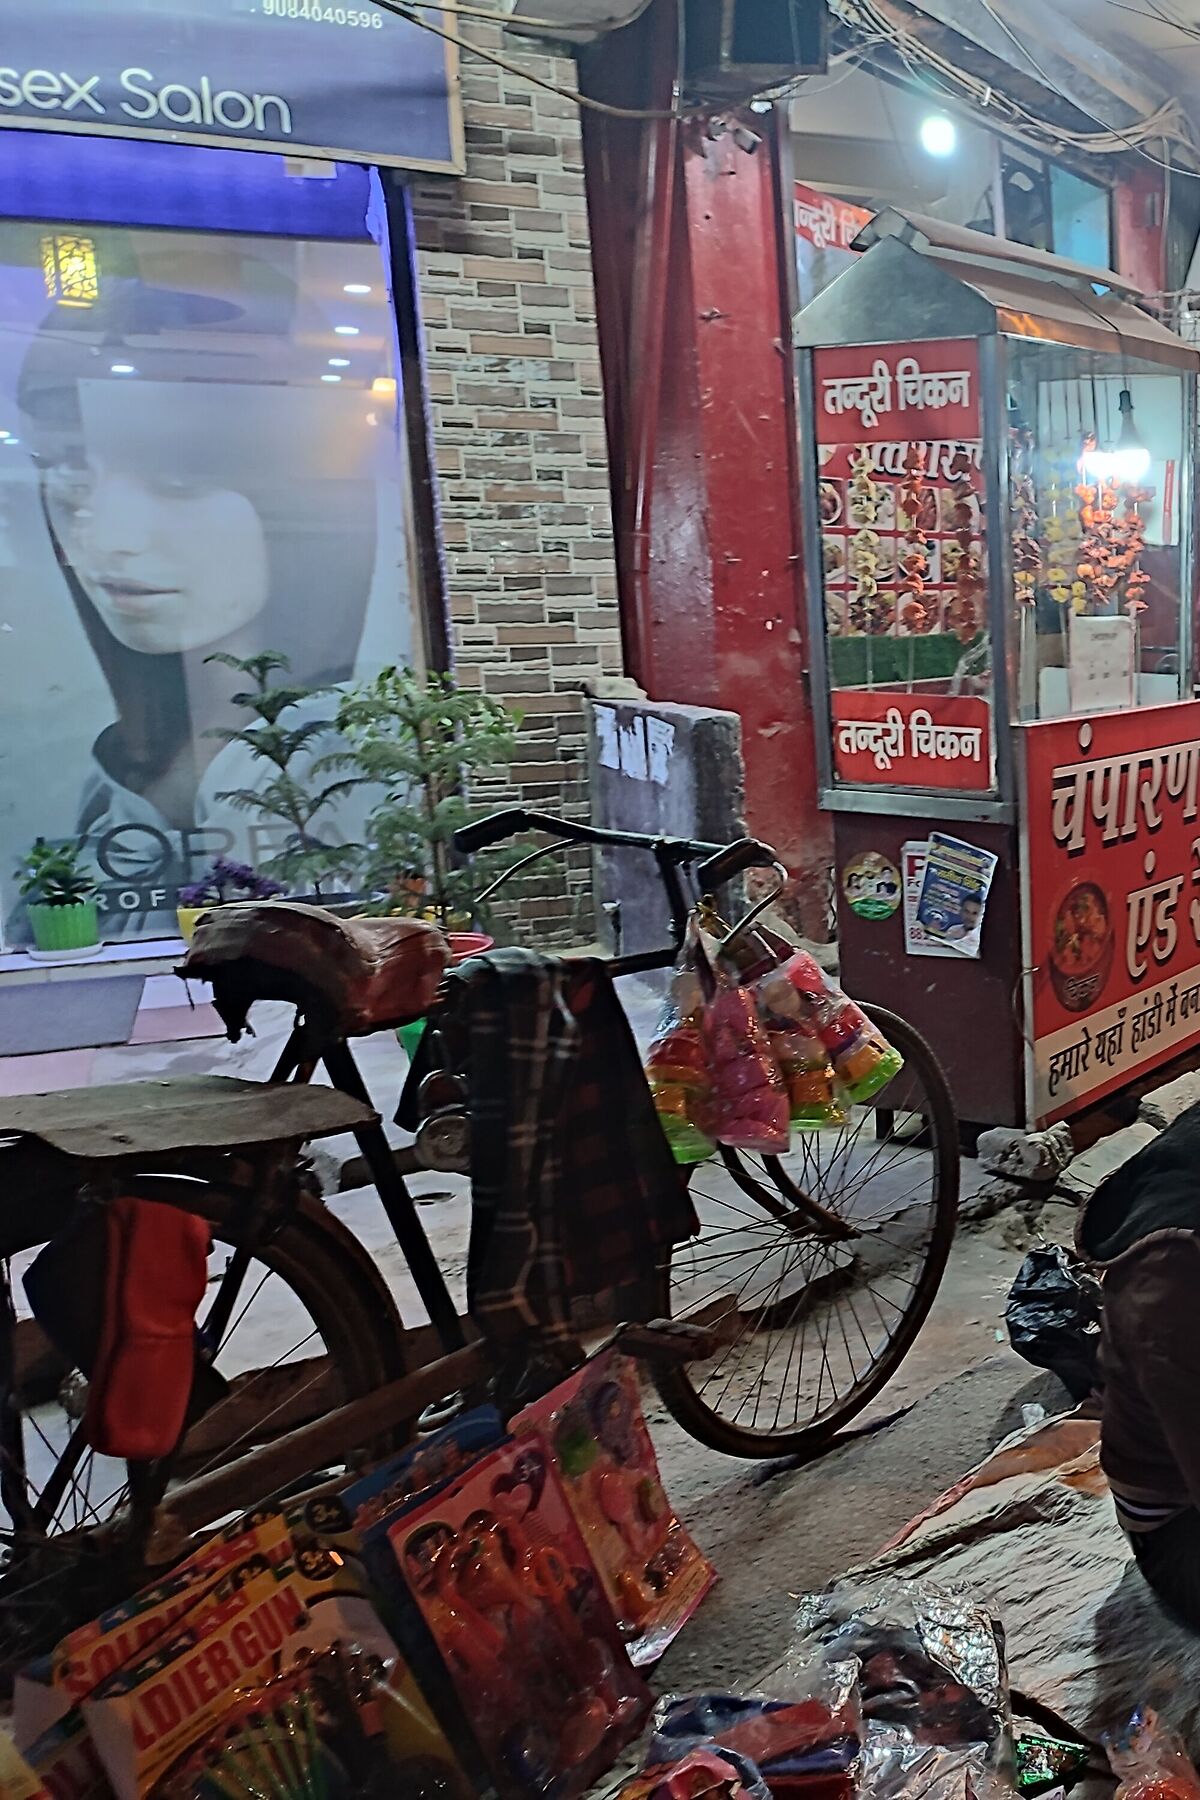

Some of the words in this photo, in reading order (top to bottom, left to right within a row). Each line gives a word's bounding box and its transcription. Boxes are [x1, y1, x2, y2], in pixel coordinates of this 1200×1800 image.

[119, 67, 292, 134] Salon
[822, 359, 893, 428] तन्दूरी
[895, 357, 971, 411] चिकन
[837, 707, 906, 770] तन्दूरी
[908, 709, 983, 762] चिकन
[1126, 850, 1184, 979] एंड
[1048, 1027, 1092, 1097] हमारे
[1095, 1007, 1128, 1066] यहाँ
[1131, 991, 1164, 1053] हांडी
[1165, 983, 1179, 1026] में
[311, 1503, 340, 1523] 3+
[229, 1585, 303, 1668] GUN
